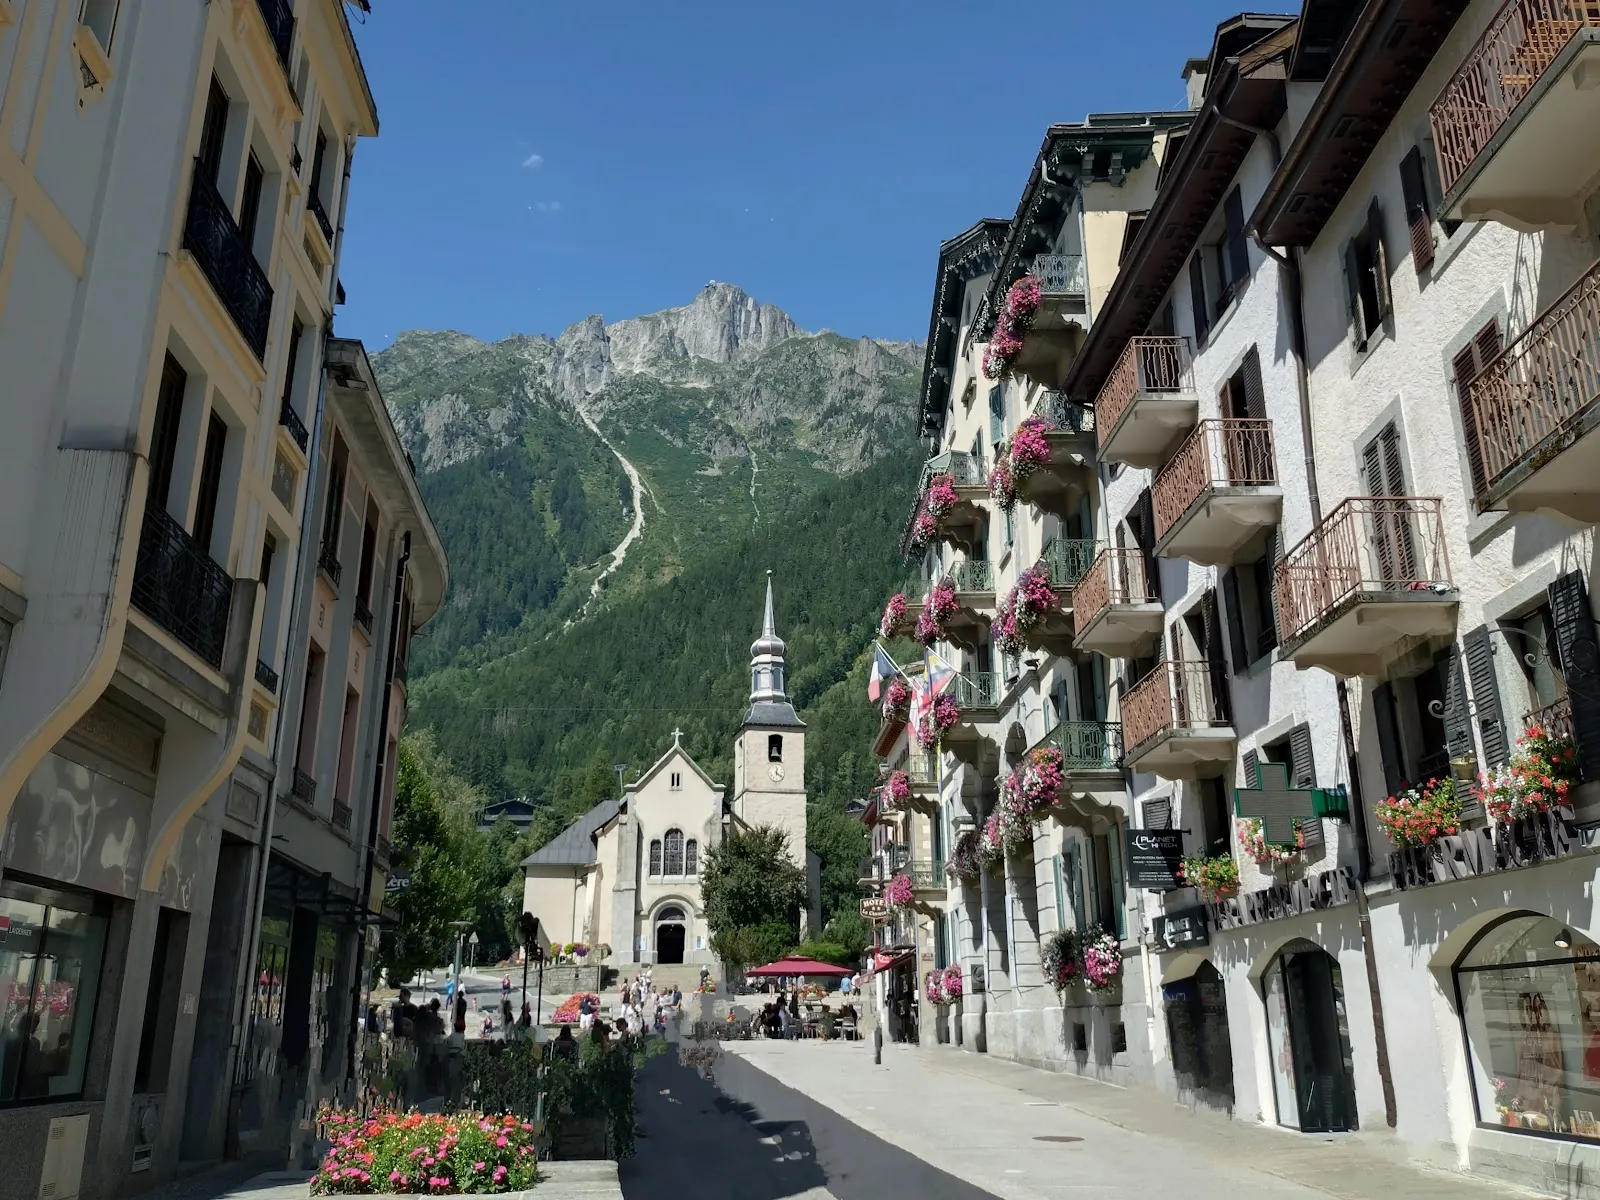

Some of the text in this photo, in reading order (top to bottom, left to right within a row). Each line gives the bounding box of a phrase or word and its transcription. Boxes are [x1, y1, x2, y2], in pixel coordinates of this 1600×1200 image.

[863, 899, 885, 907] HOTE
[1577, 948, 1600, 957] NUX
[1521, 1038, 1543, 1047] NUXE
